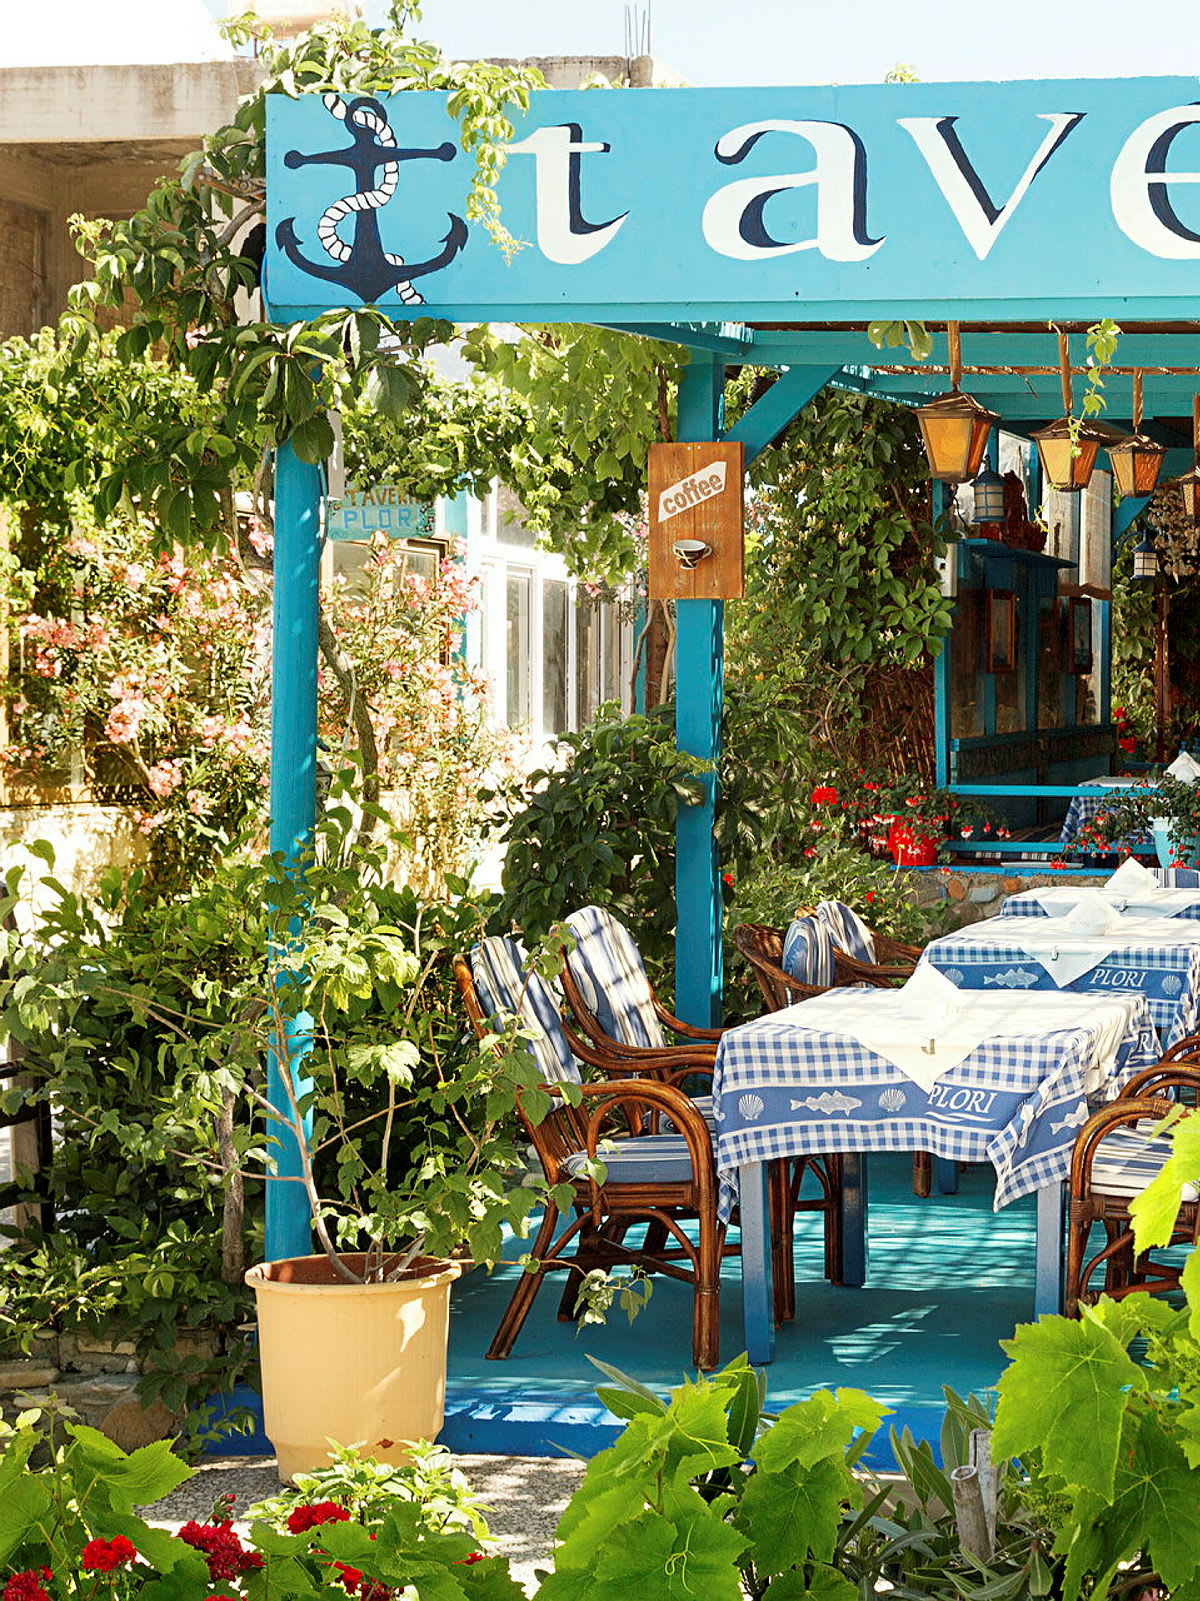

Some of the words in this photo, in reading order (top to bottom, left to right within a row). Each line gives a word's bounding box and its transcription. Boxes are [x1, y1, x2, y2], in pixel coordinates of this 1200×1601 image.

[662, 473, 724, 515] coffee
[1089, 968, 1149, 988] PLORI
[926, 1084, 999, 1114] PLORI
